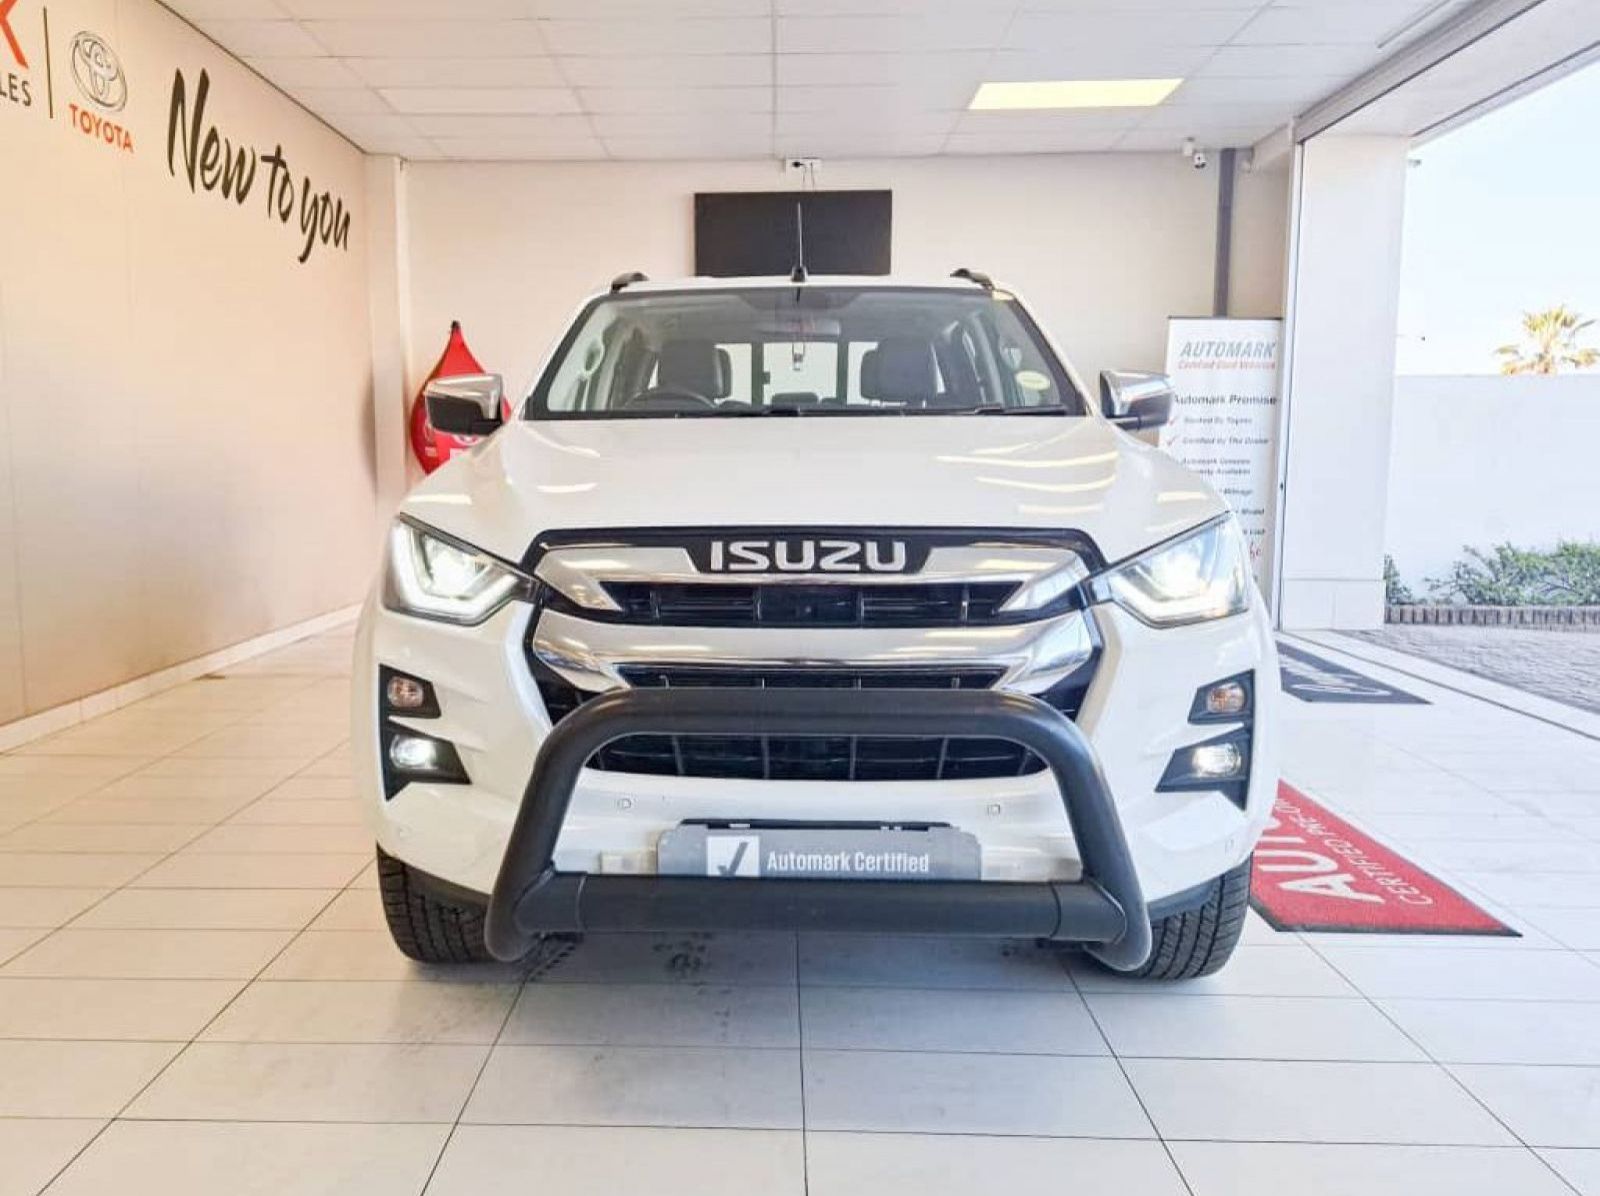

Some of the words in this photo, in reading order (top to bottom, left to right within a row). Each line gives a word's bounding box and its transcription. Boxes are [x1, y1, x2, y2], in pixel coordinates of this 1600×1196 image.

[69, 103, 134, 153] TOYOTA
[167, 67, 256, 204] New
[261, 144, 294, 223] to
[298, 176, 350, 263] you
[1180, 341, 1276, 358] AUTOMARK
[710, 541, 906, 571] ISUZU
[767, 851, 851, 873] Automark
[854, 852, 930, 873] Certified
[1324, 838, 1434, 905] CERTIFIED
